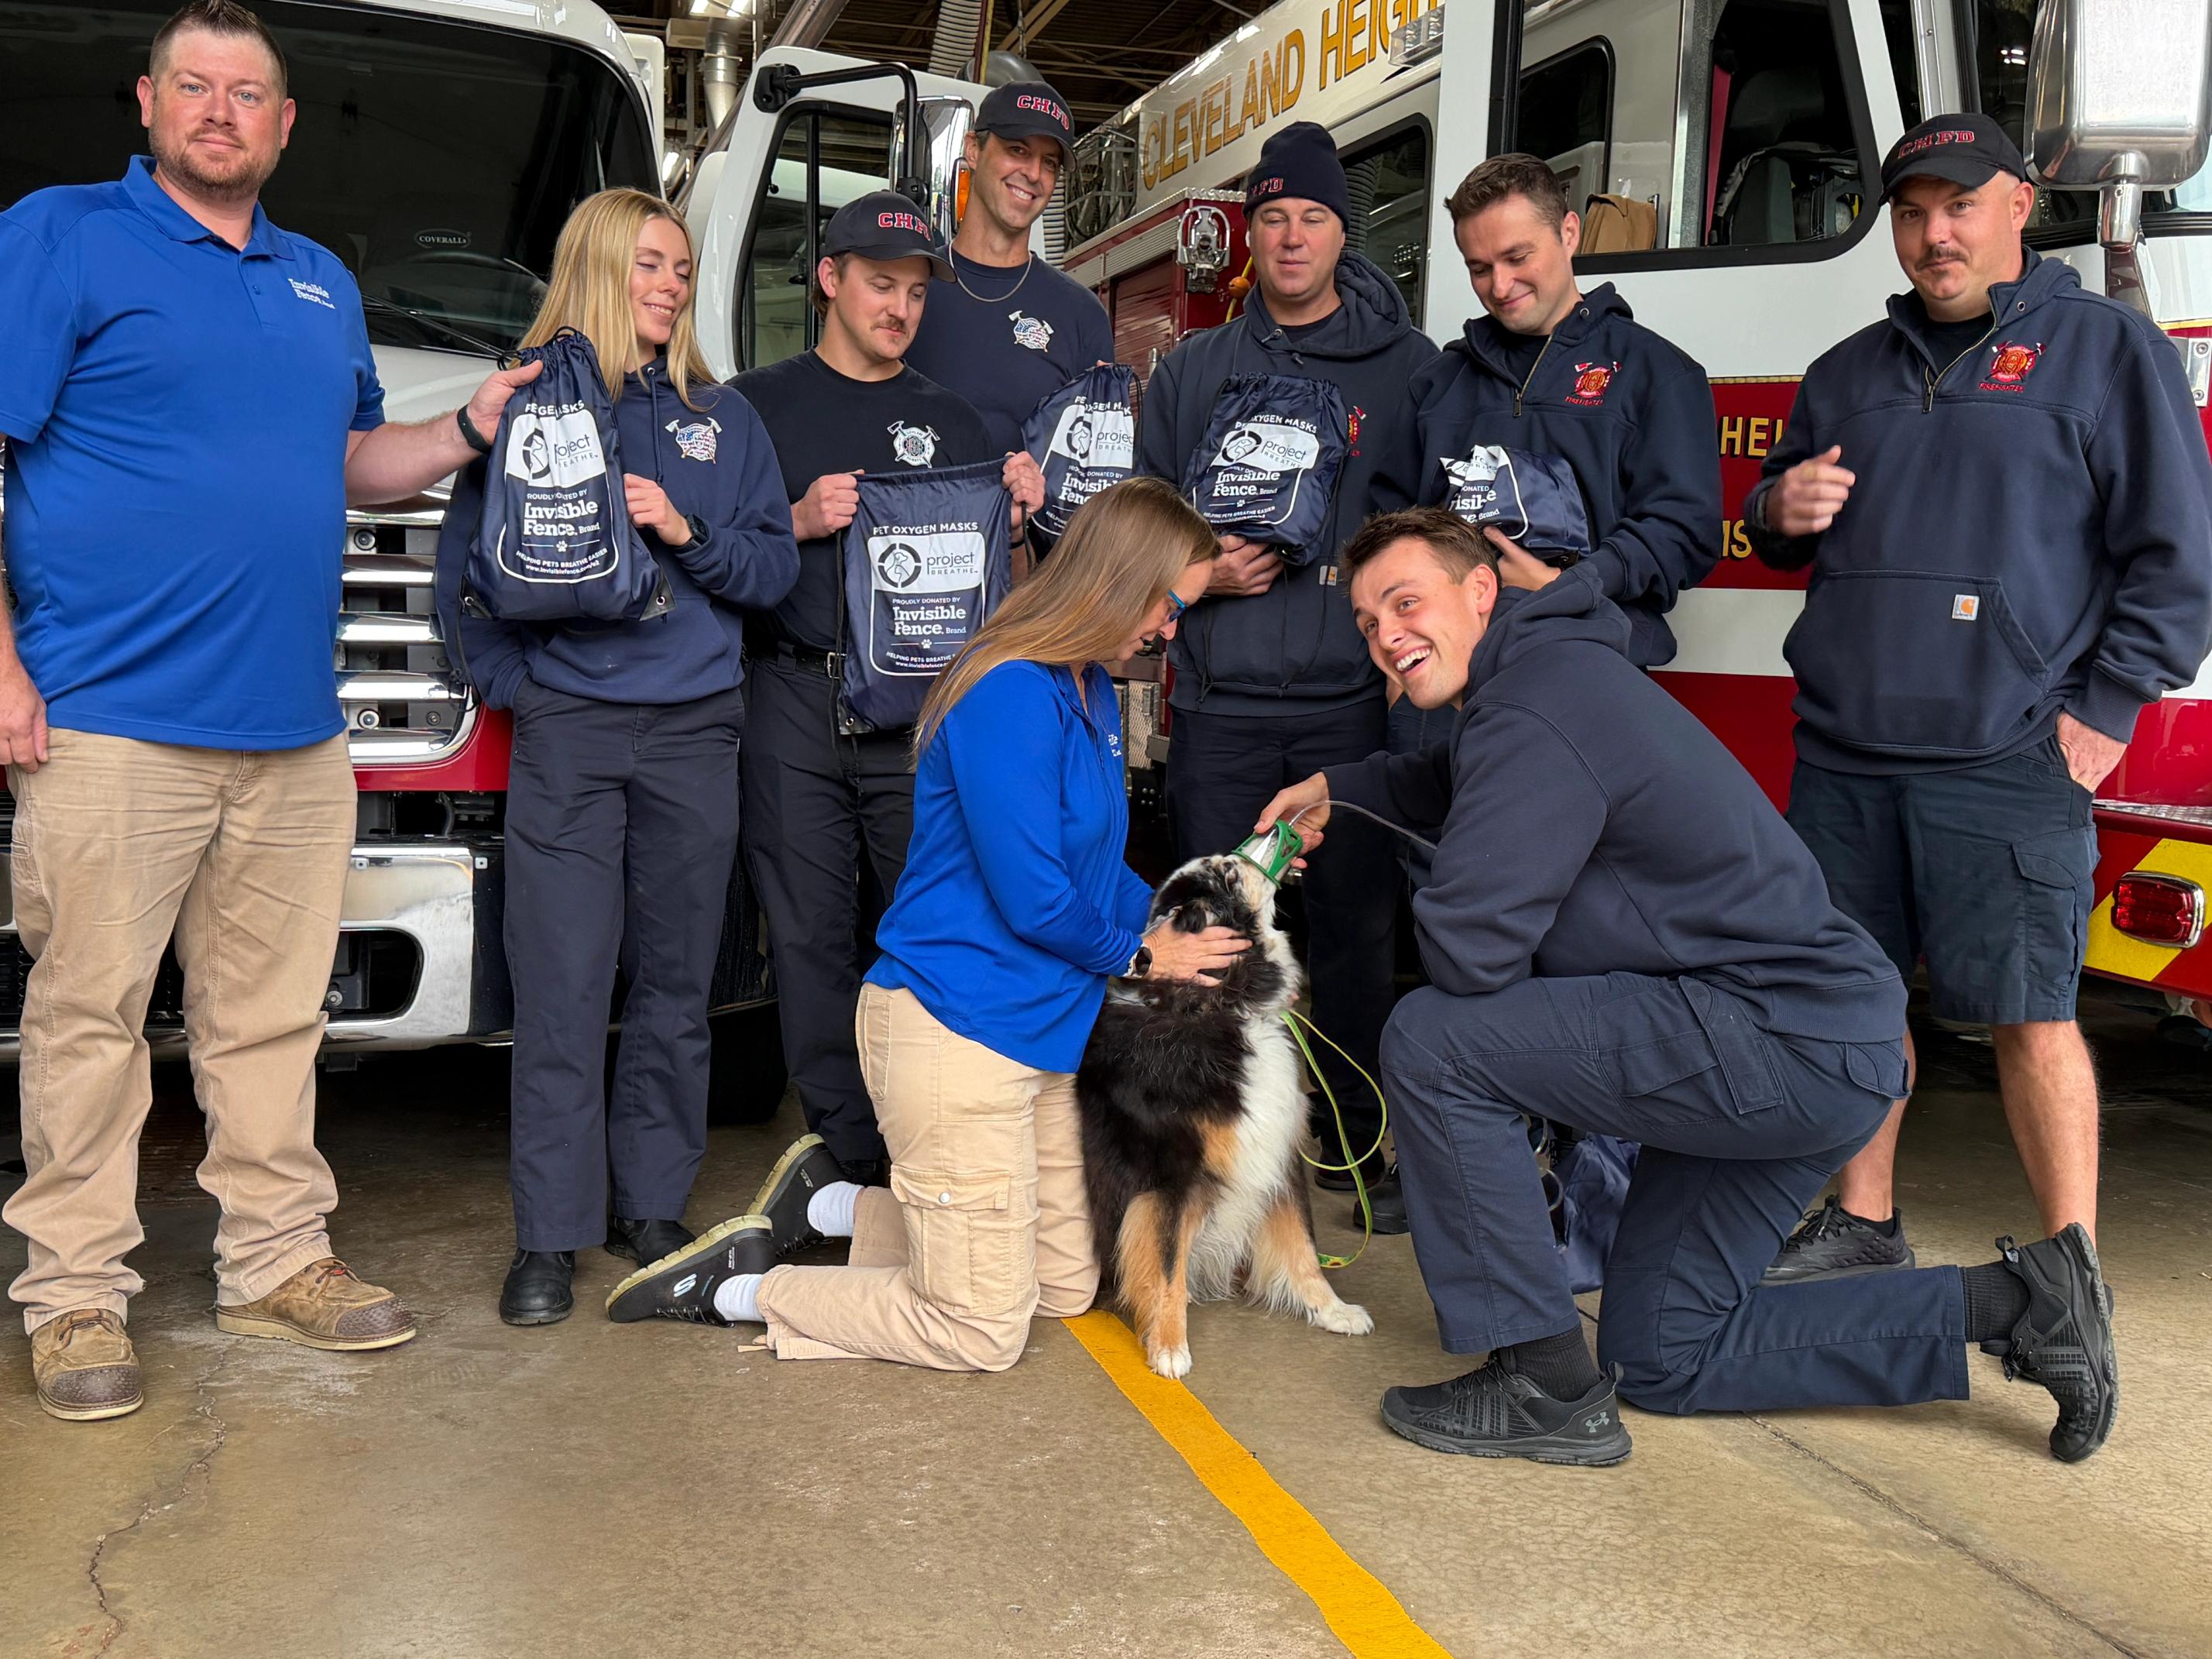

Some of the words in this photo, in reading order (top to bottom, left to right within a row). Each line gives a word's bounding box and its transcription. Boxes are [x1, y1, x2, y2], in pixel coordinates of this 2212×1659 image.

[1142, 28, 1306, 191] CLEVELAND
[1284, 418, 1317, 434] MASKS
[1260, 440, 1307, 461] project
[1215, 469, 1280, 484] Invisible
[524, 499, 599, 519] Invisible
[1478, 508, 1500, 520] Brand
[579, 522, 600, 534] Brand
[873, 526, 889, 535] PET
[891, 524, 936, 534] OXYGEN
[939, 522, 978, 532] MASKS
[516, 550, 541, 565] HELPING
[561, 555, 588, 568] BREATHE
[588, 548, 608, 561] EASIER
[926, 551, 975, 575] project
[892, 605, 967, 621] Invisible
[886, 651, 910, 661] HELPING
[926, 654, 951, 663] BREATHE
